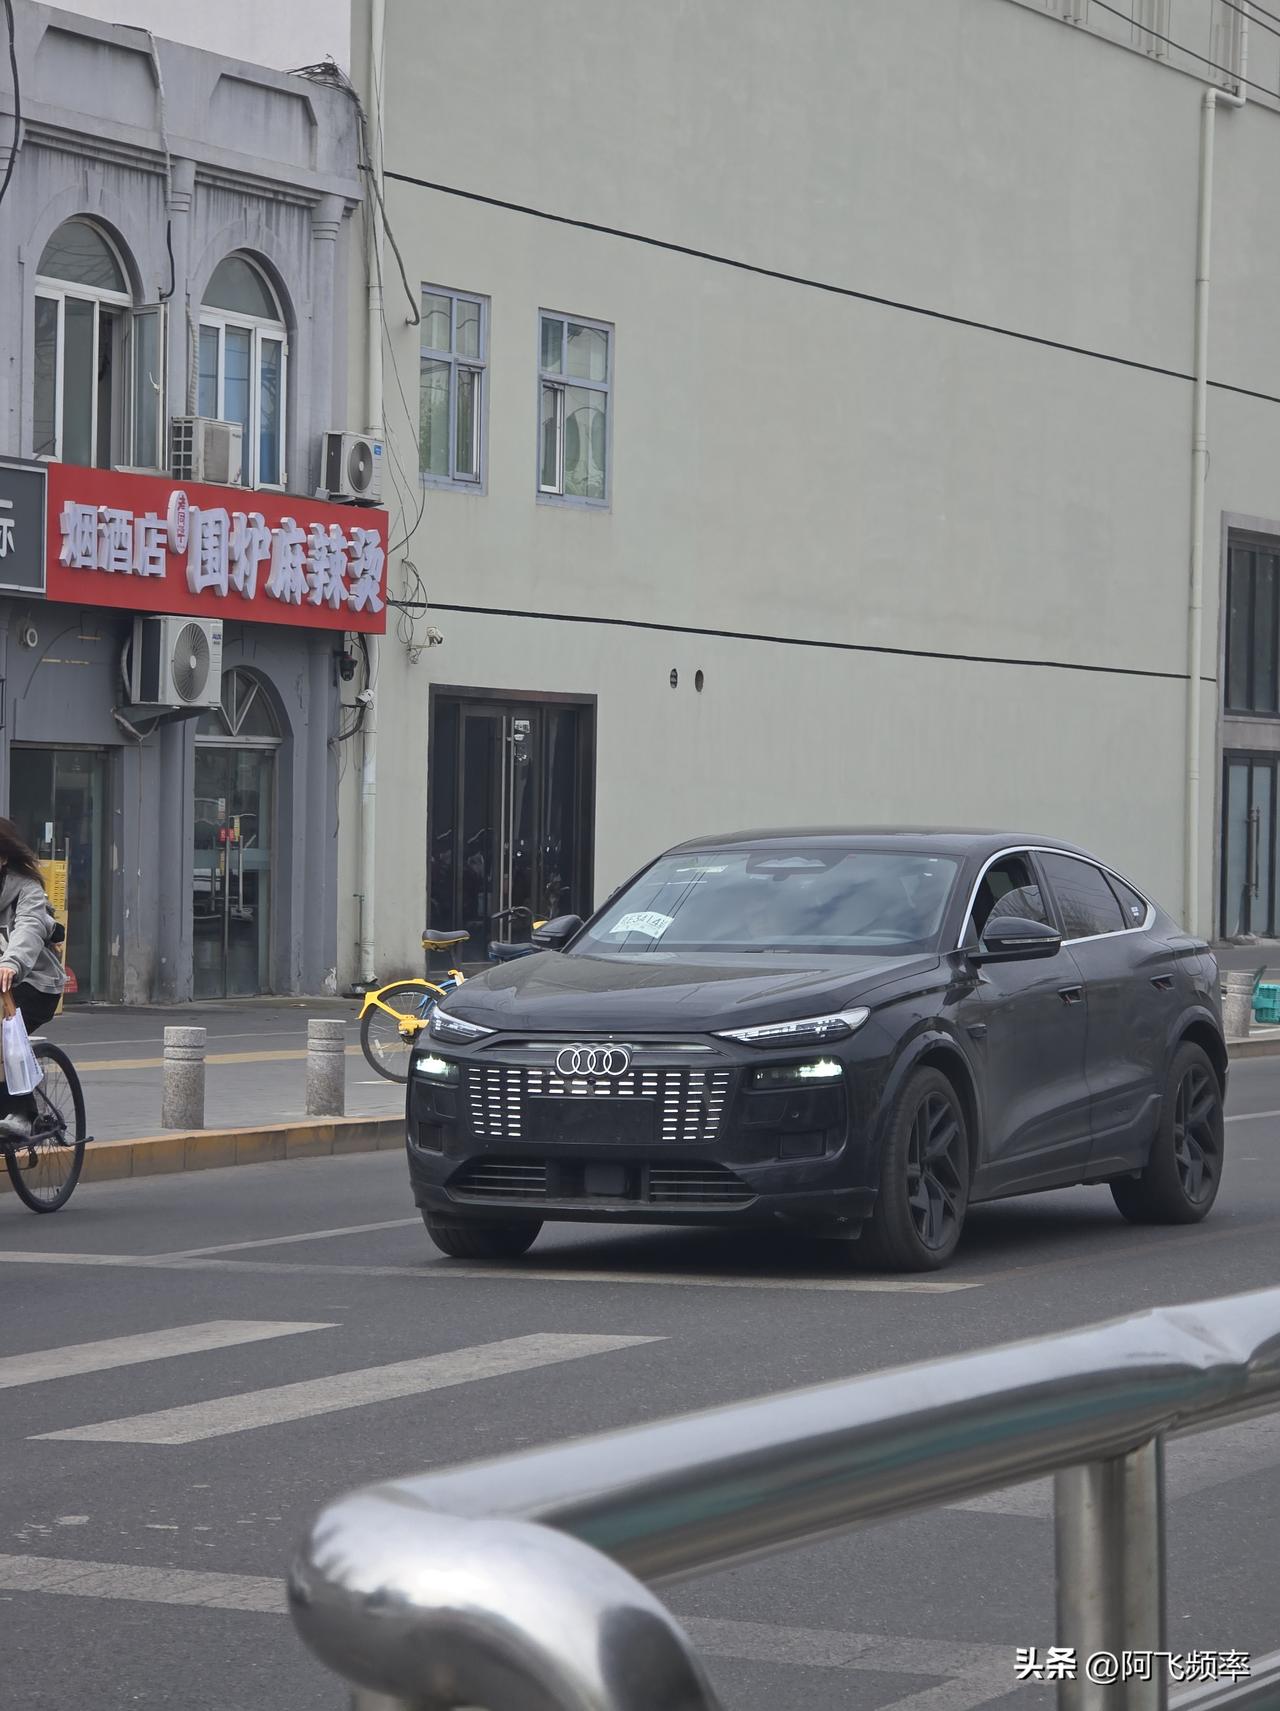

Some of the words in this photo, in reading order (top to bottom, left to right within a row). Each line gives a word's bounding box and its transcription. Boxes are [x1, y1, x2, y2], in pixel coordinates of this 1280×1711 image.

[59, 500, 168, 578] 烟酒店
[186, 506, 386, 614] 围炉麻辣烫
